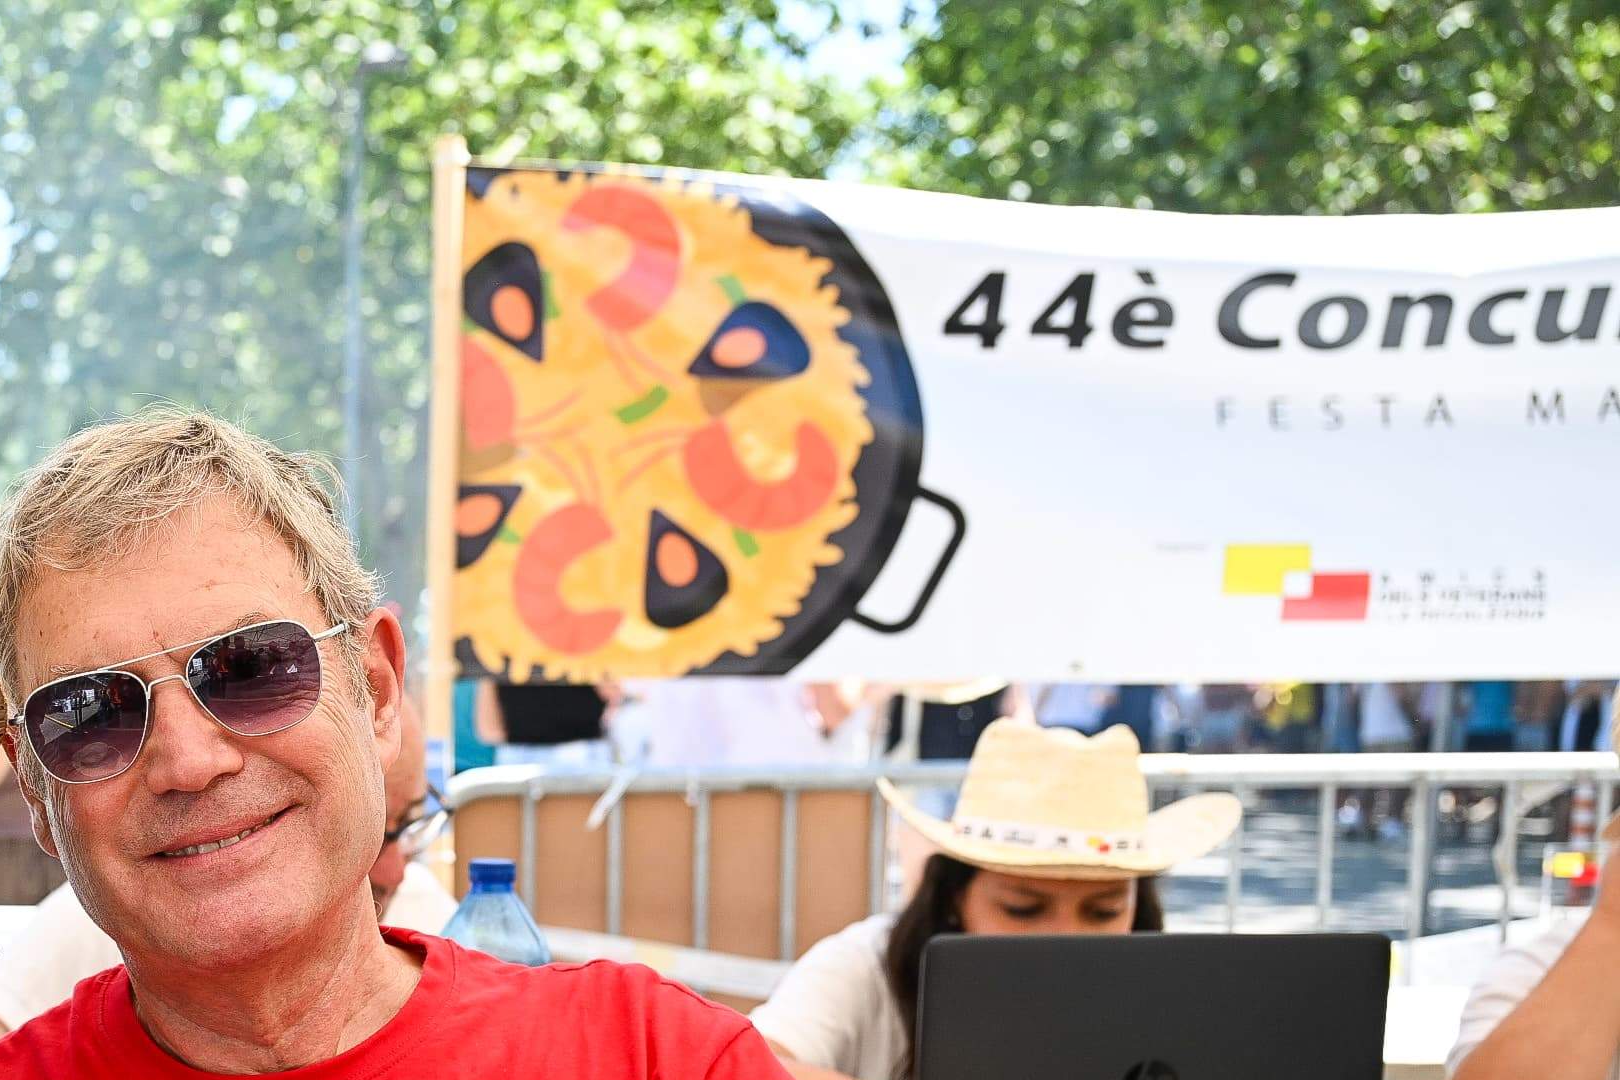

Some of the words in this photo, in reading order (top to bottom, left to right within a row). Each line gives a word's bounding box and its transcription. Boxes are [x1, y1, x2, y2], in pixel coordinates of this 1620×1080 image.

[943, 272, 1175, 349] 44è
[1217, 272, 1620, 350] Concu
[1216, 394, 1455, 430] FESTA
